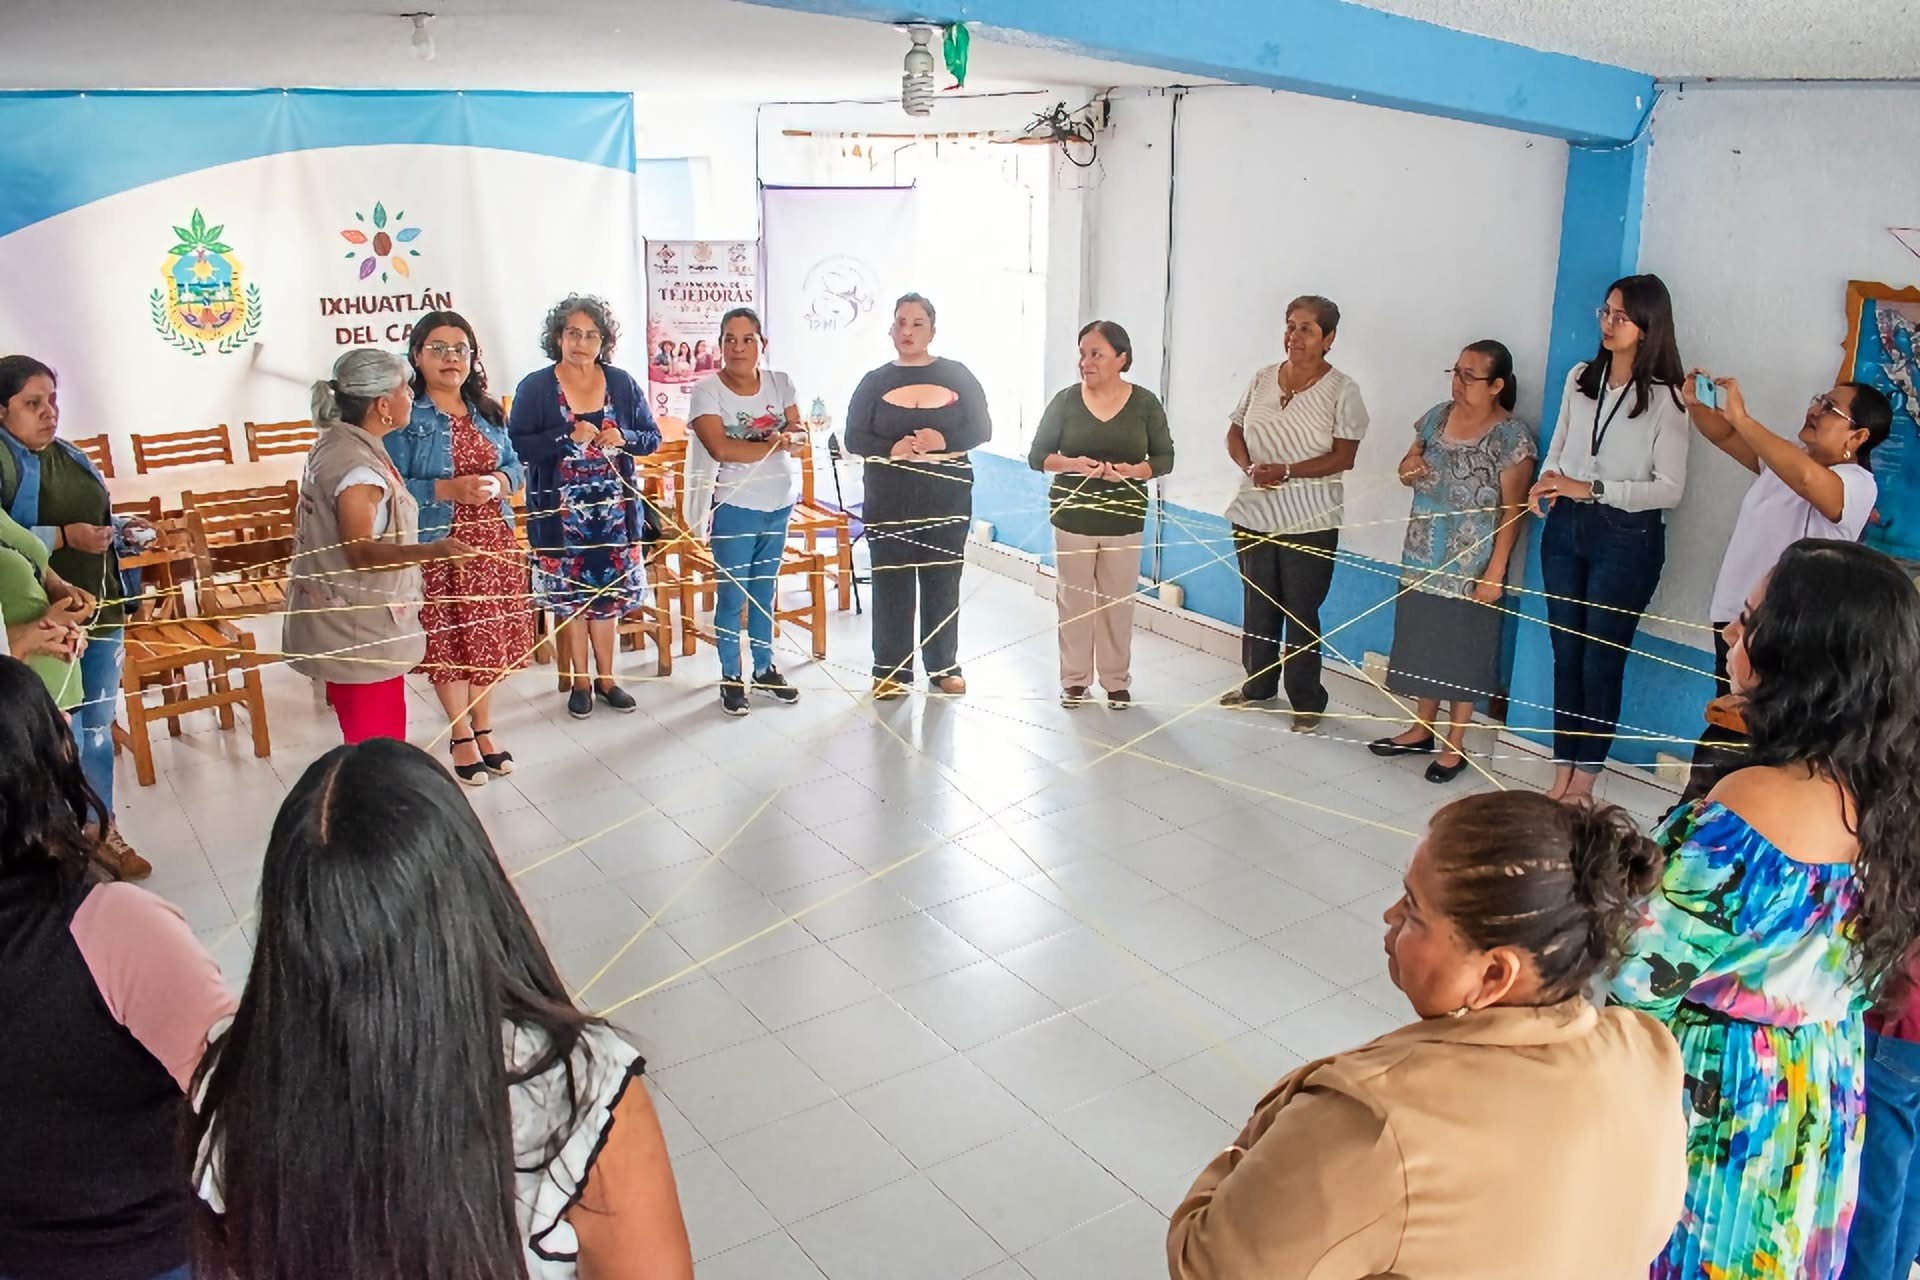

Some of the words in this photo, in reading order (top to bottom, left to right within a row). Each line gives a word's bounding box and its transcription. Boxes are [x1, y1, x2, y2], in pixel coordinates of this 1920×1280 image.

[320, 288, 453, 316] IXHUATLÁN
[658, 288, 753, 303] TEJEDORAS
[336, 326, 378, 345] DEL
[386, 323, 413, 343] CA
